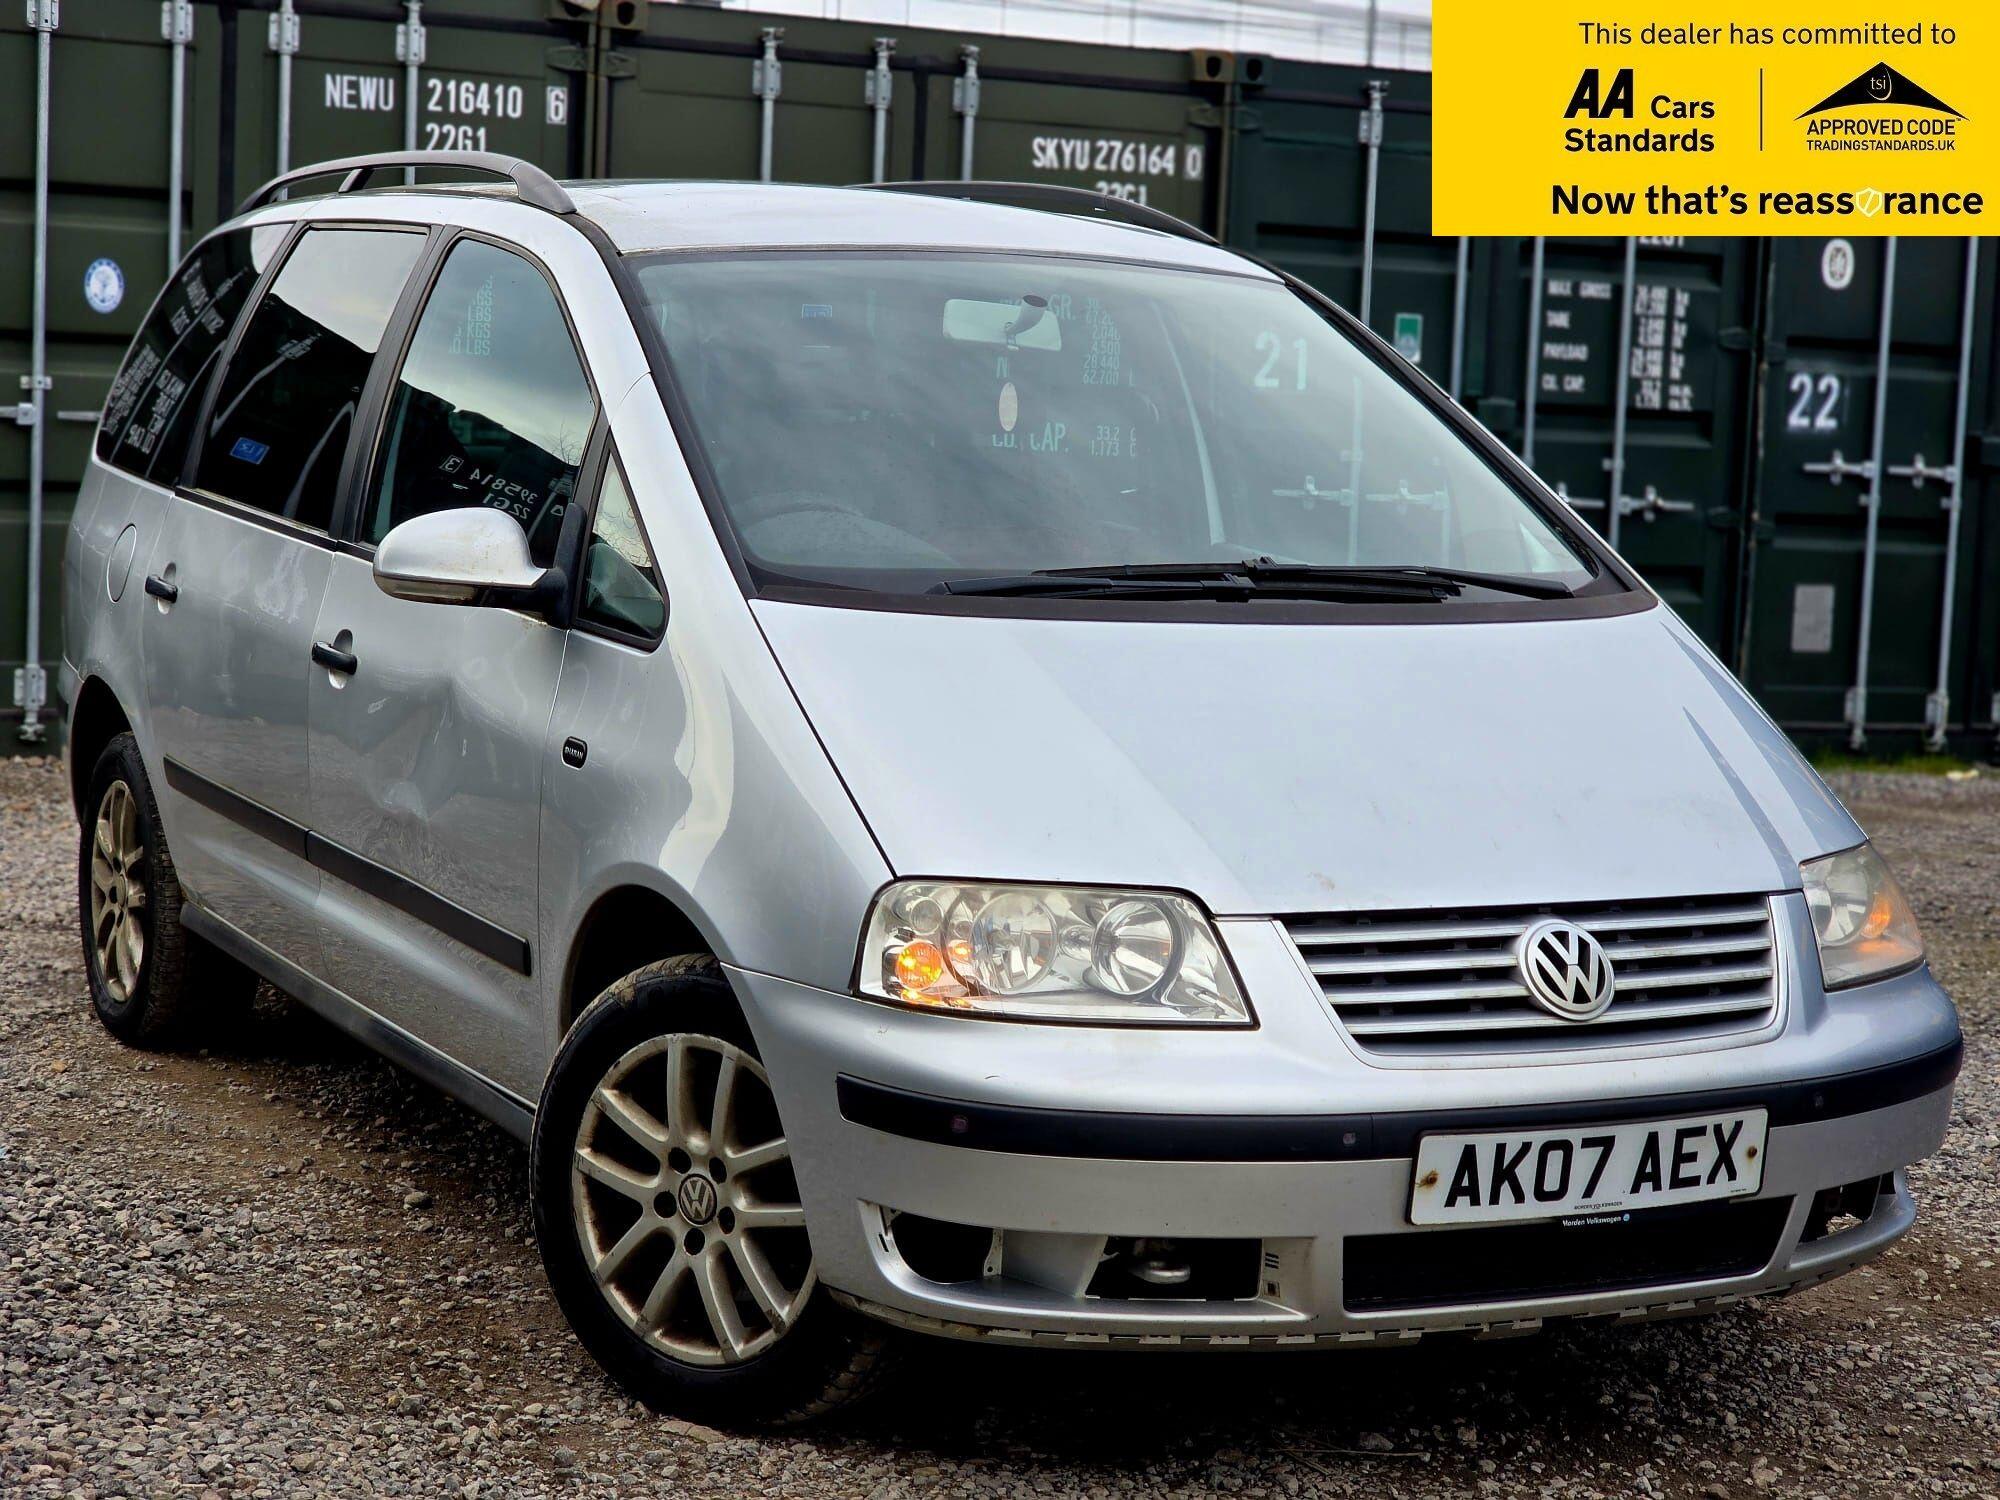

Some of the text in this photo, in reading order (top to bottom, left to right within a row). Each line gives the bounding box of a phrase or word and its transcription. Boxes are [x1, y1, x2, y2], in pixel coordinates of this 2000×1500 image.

[325, 73, 566, 123] NEWU 216410 6
[425, 123, 487, 151] 22G1
[1032, 136, 1090, 171] SKYU
[1093, 139, 1176, 177] 276164
[1254, 330, 1308, 391] 21
[1789, 373, 1840, 429] 22
[1443, 1120, 1744, 1209] AK07 AEX
